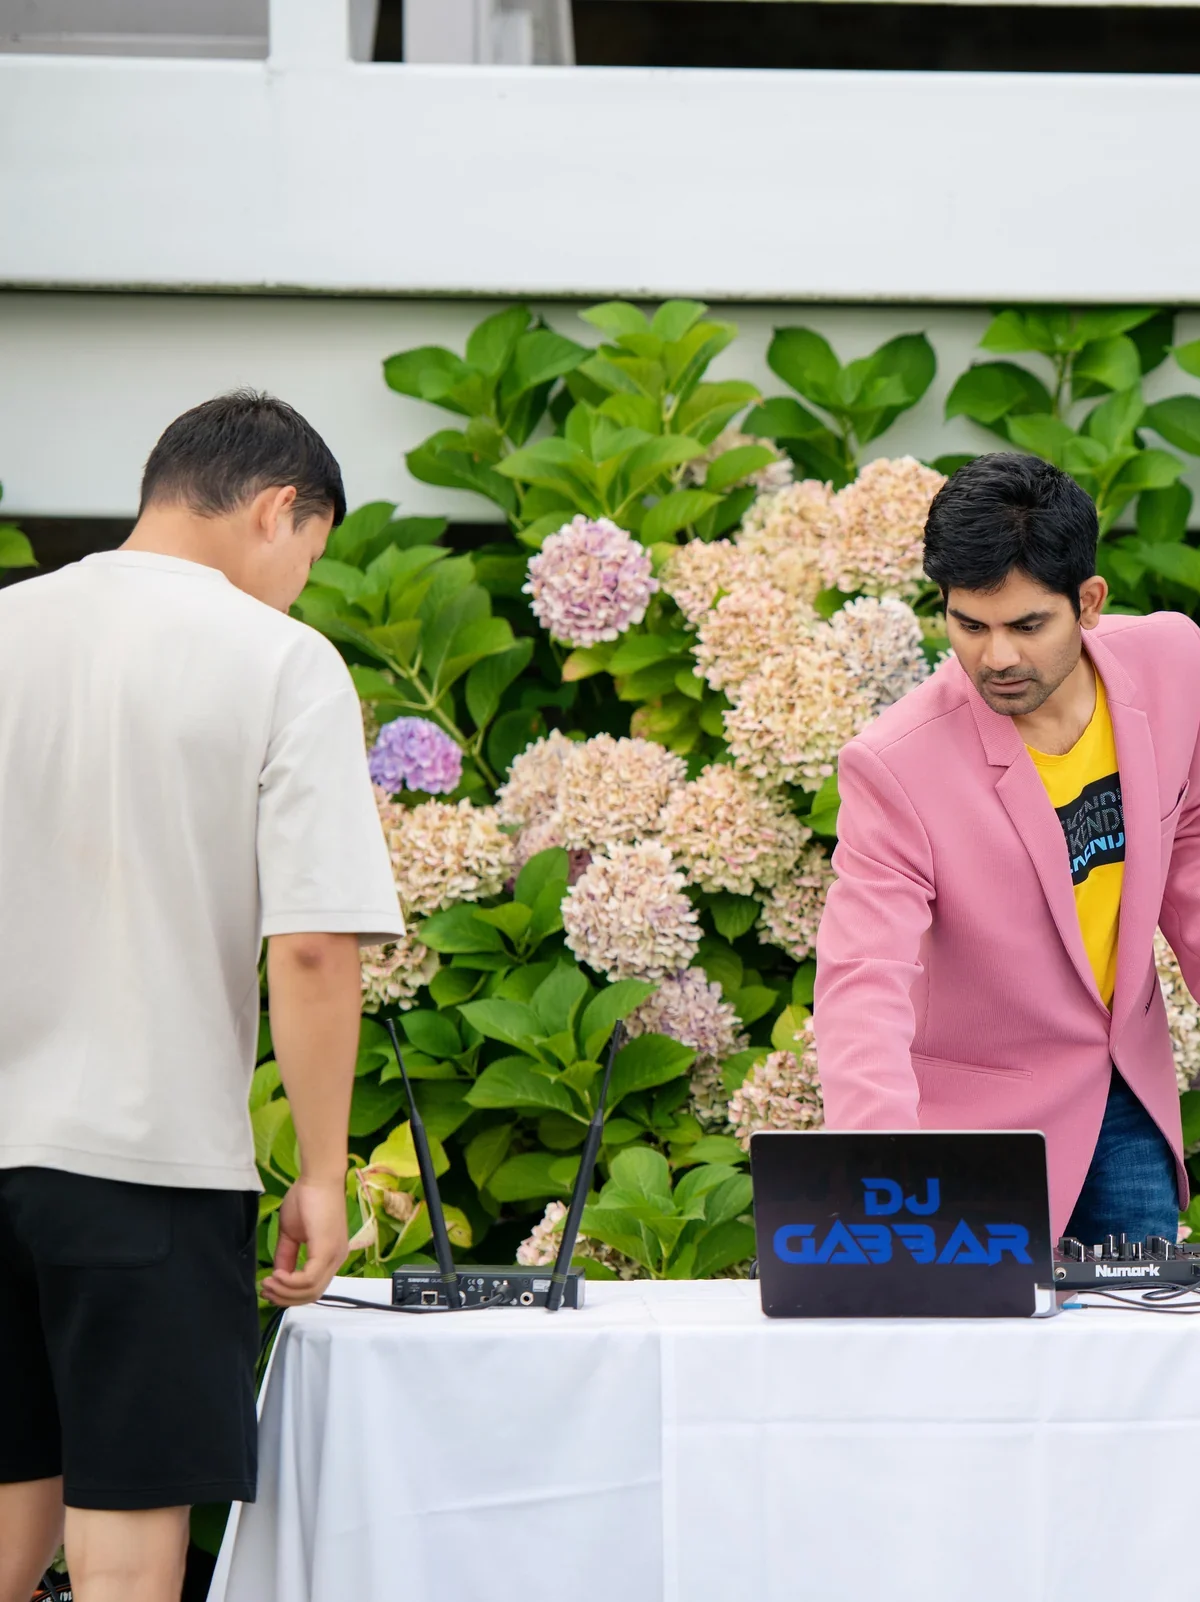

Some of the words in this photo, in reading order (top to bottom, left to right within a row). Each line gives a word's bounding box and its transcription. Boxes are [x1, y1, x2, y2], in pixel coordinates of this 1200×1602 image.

[860, 1177, 941, 1217] DJ
[772, 1218, 1035, 1266] GABBAR
[1095, 1263, 1160, 1278] Numark
